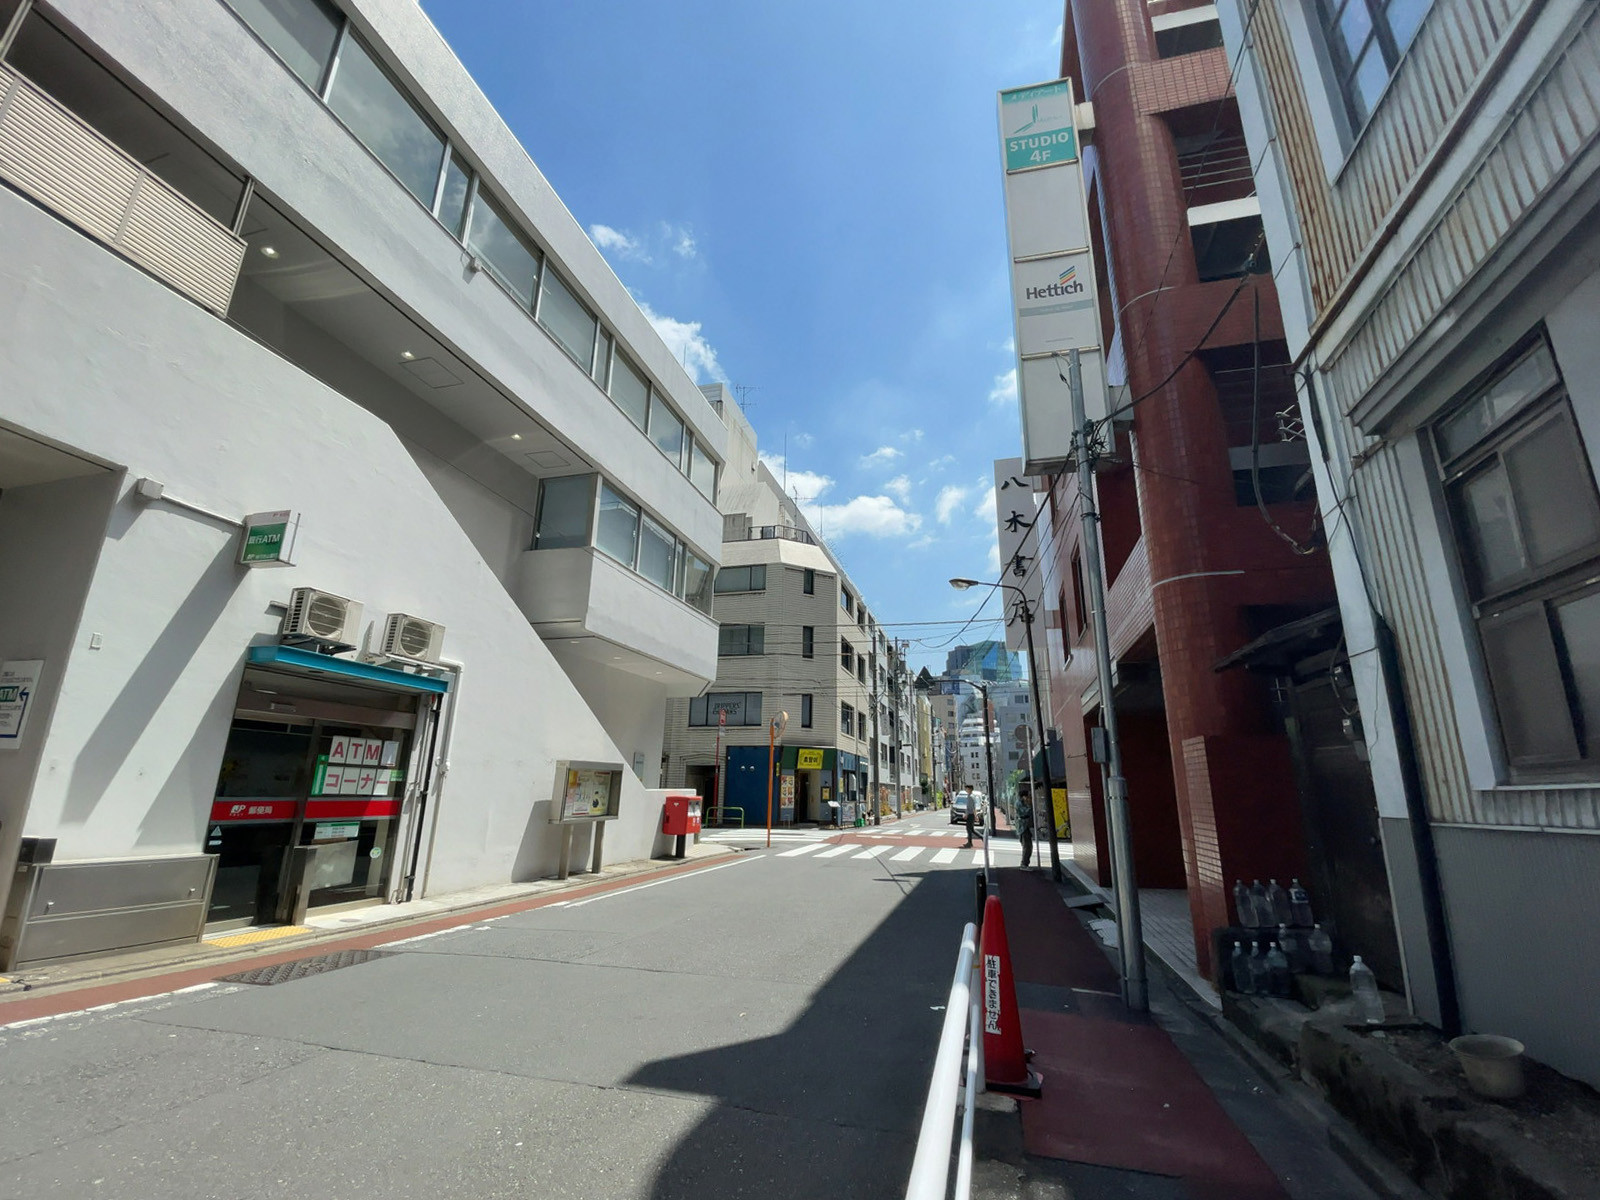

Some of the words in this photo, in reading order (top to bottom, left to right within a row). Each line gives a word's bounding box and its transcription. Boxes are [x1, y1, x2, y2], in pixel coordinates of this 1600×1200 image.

[1010, 132, 1069, 152] STUDIO
[1030, 150, 1051, 162] 4F
[1026, 280, 1084, 300] Hettich
[1001, 476, 1035, 628] 八木書店
[331, 741, 381, 760] ATM
[326, 774, 388, 789] コーナー
[987, 957, 998, 1031] 駐車できません
